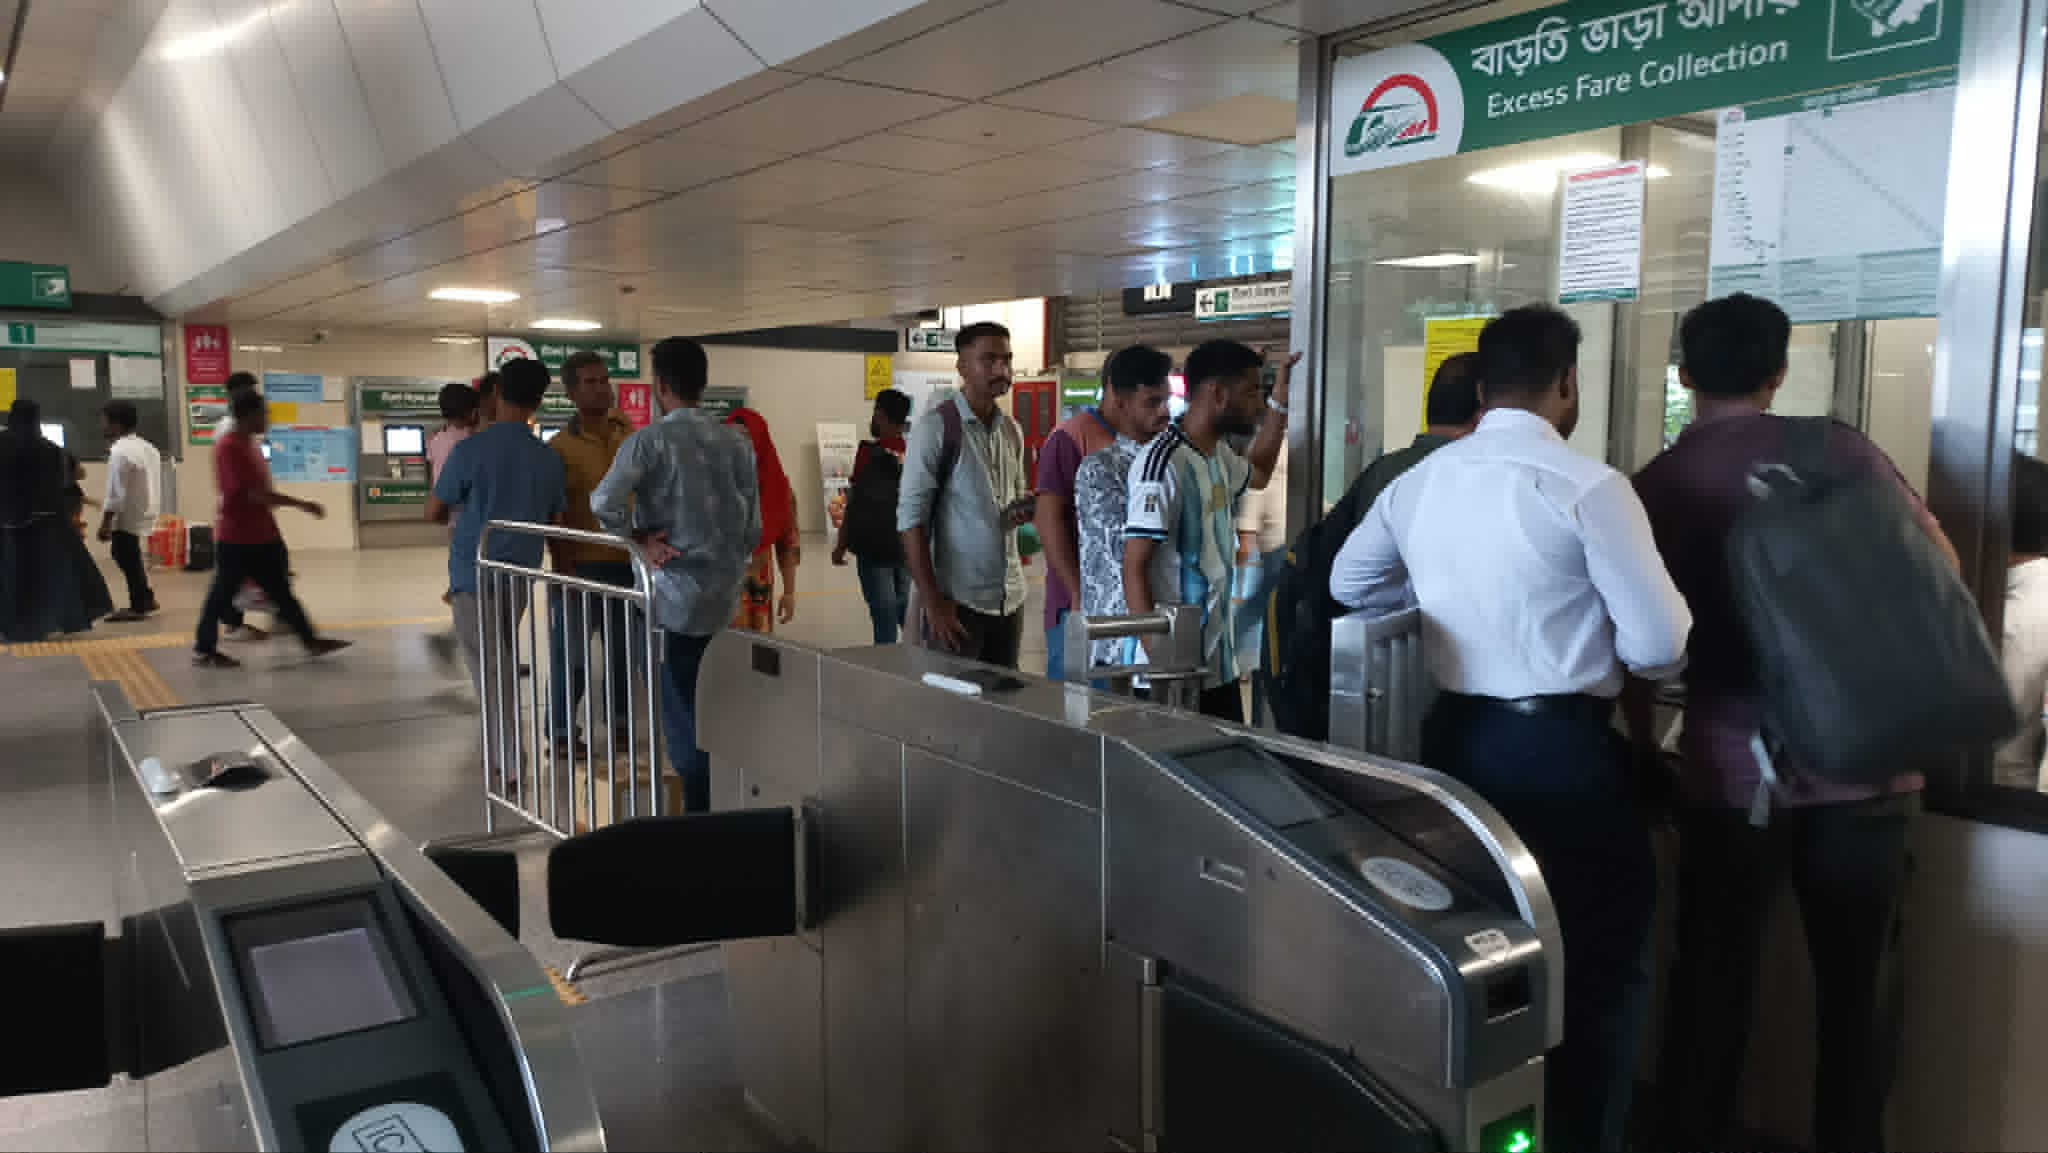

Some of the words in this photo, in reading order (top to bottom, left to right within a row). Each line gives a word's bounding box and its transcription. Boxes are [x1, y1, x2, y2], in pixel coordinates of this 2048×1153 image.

[1471, 16, 1570, 77] বাড়তি
[1578, 2, 1668, 52] ভাড়া
[1487, 84, 1569, 118] Excess
[1576, 72, 1633, 101] Fare
[1639, 40, 1789, 89] Collection
